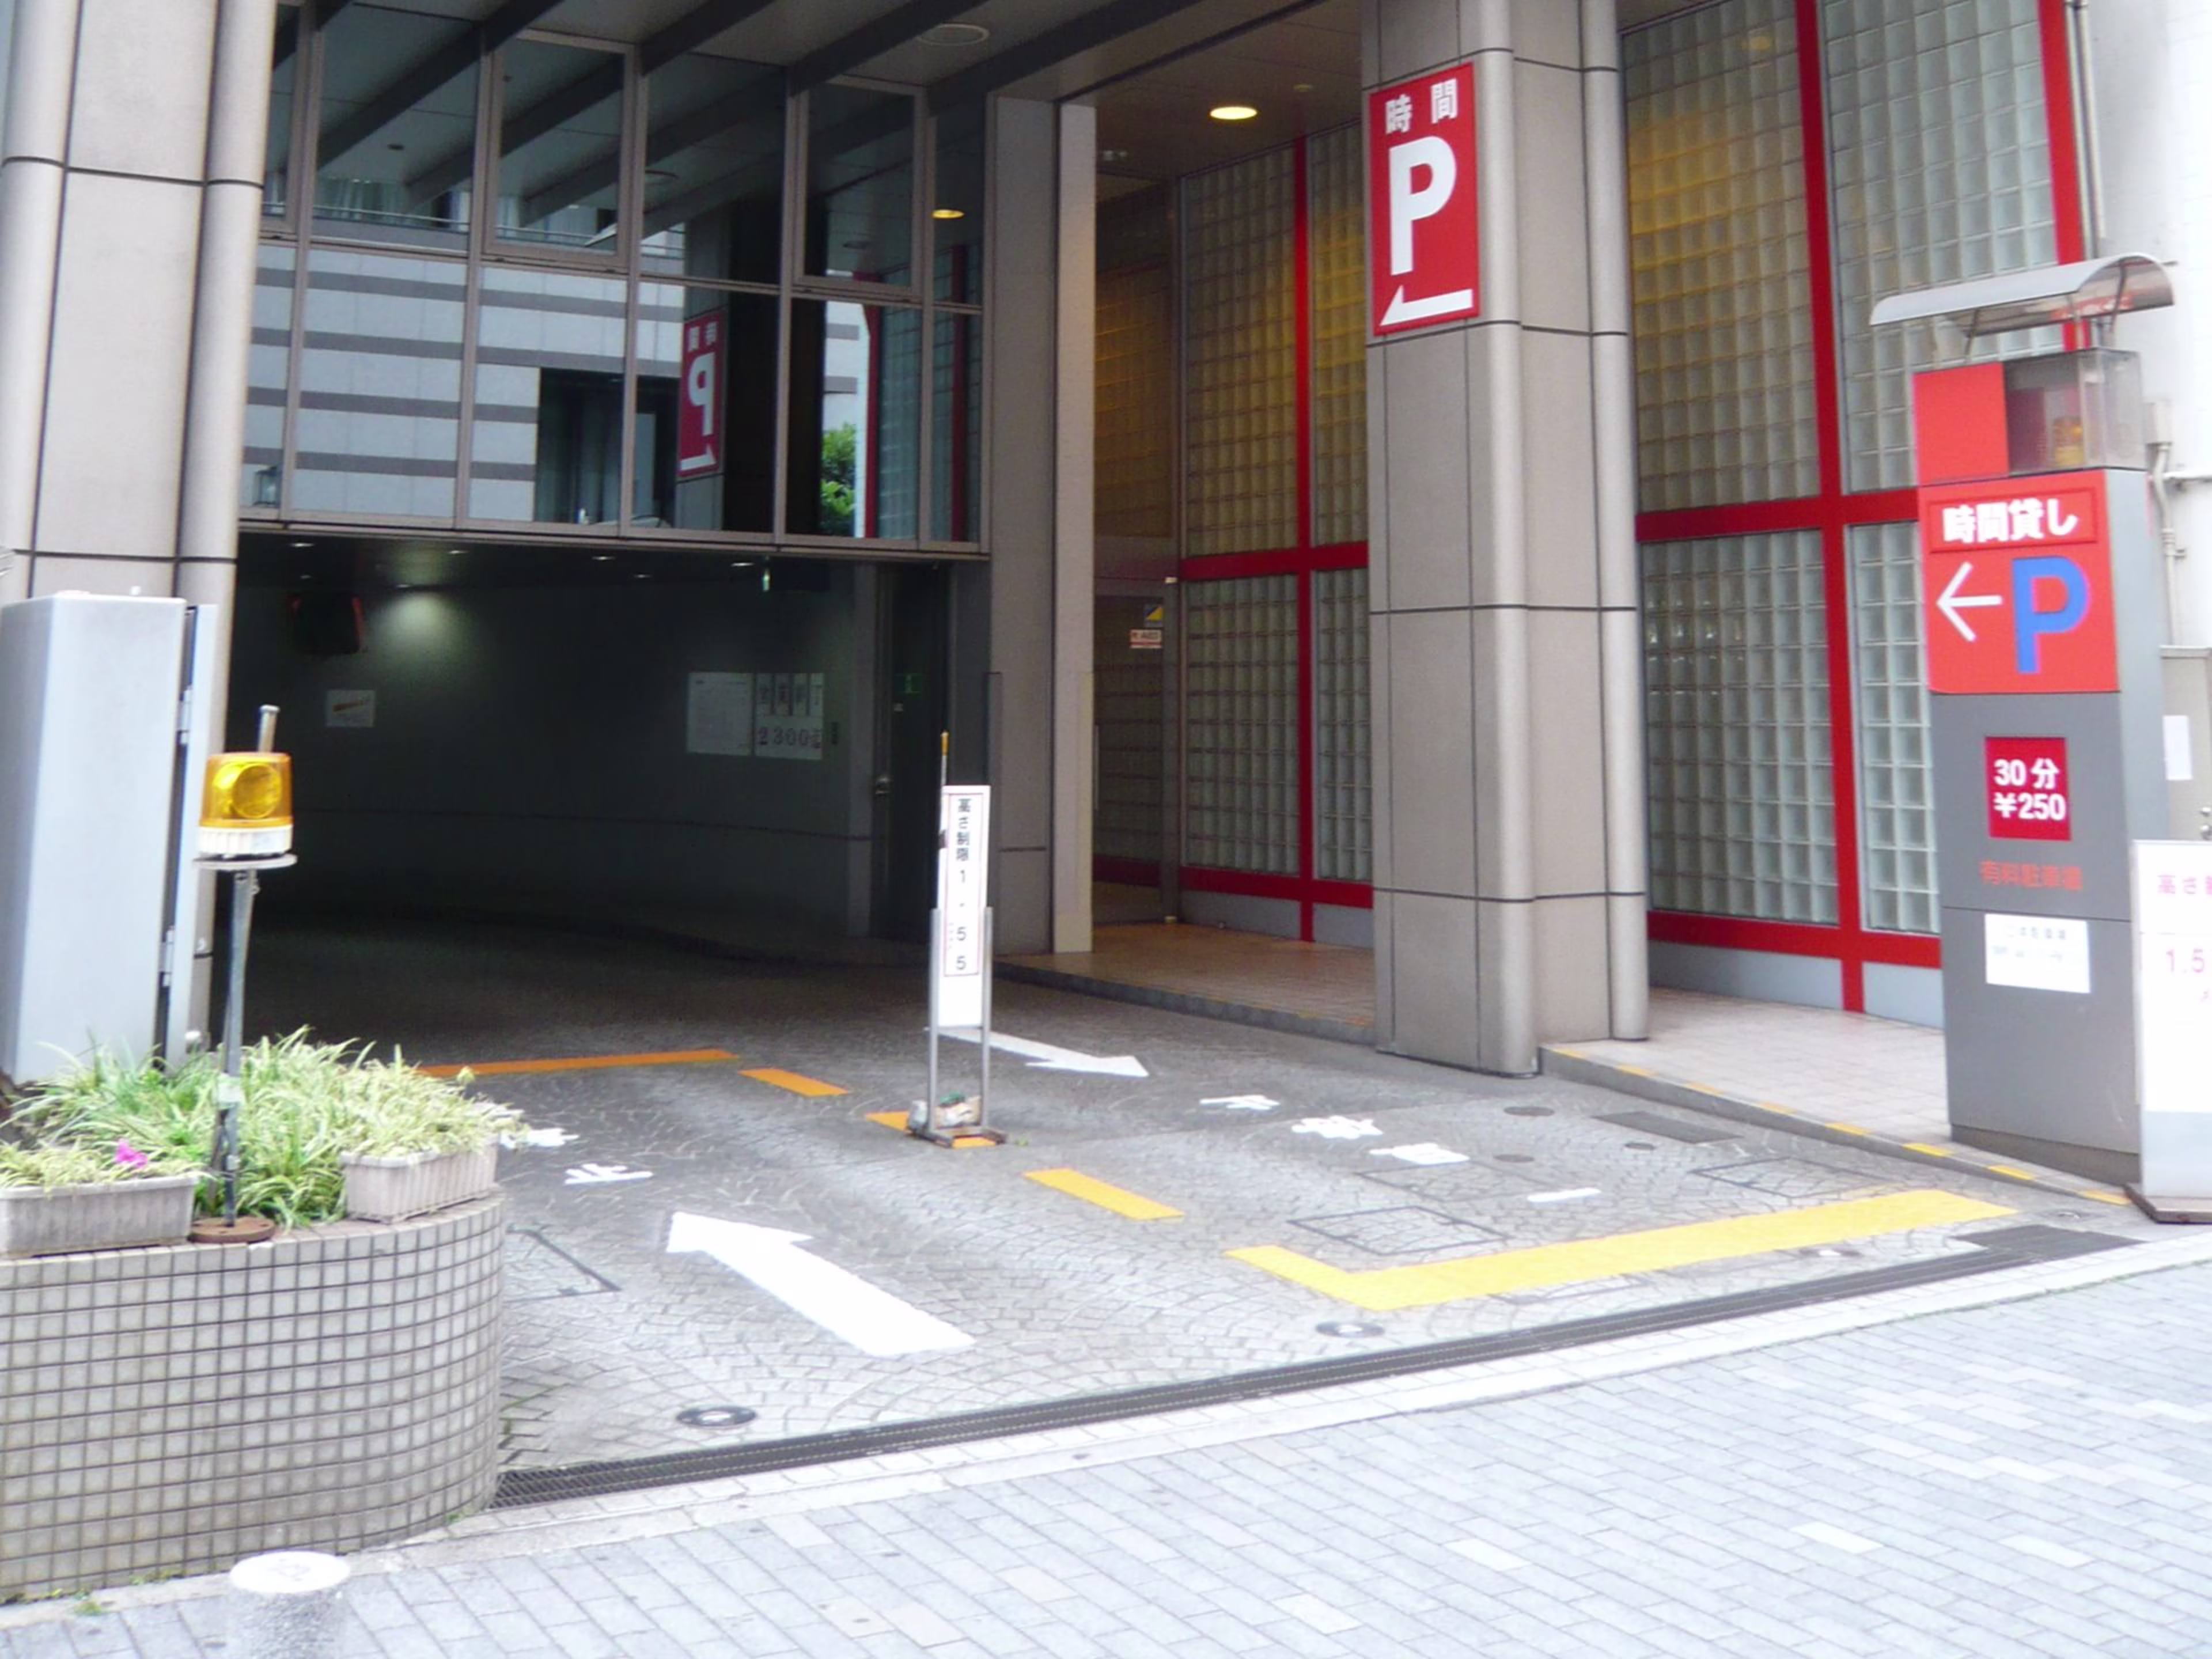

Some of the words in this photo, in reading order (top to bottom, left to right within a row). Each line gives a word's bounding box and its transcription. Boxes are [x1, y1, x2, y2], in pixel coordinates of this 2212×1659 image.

[1386, 78, 1458, 135] 時間
[1389, 135, 1456, 276] P
[1942, 497, 2078, 544] 時間貸し
[2011, 555, 2091, 673] P
[1993, 757, 2060, 789] 30分
[1993, 791, 2066, 821] ¥250
